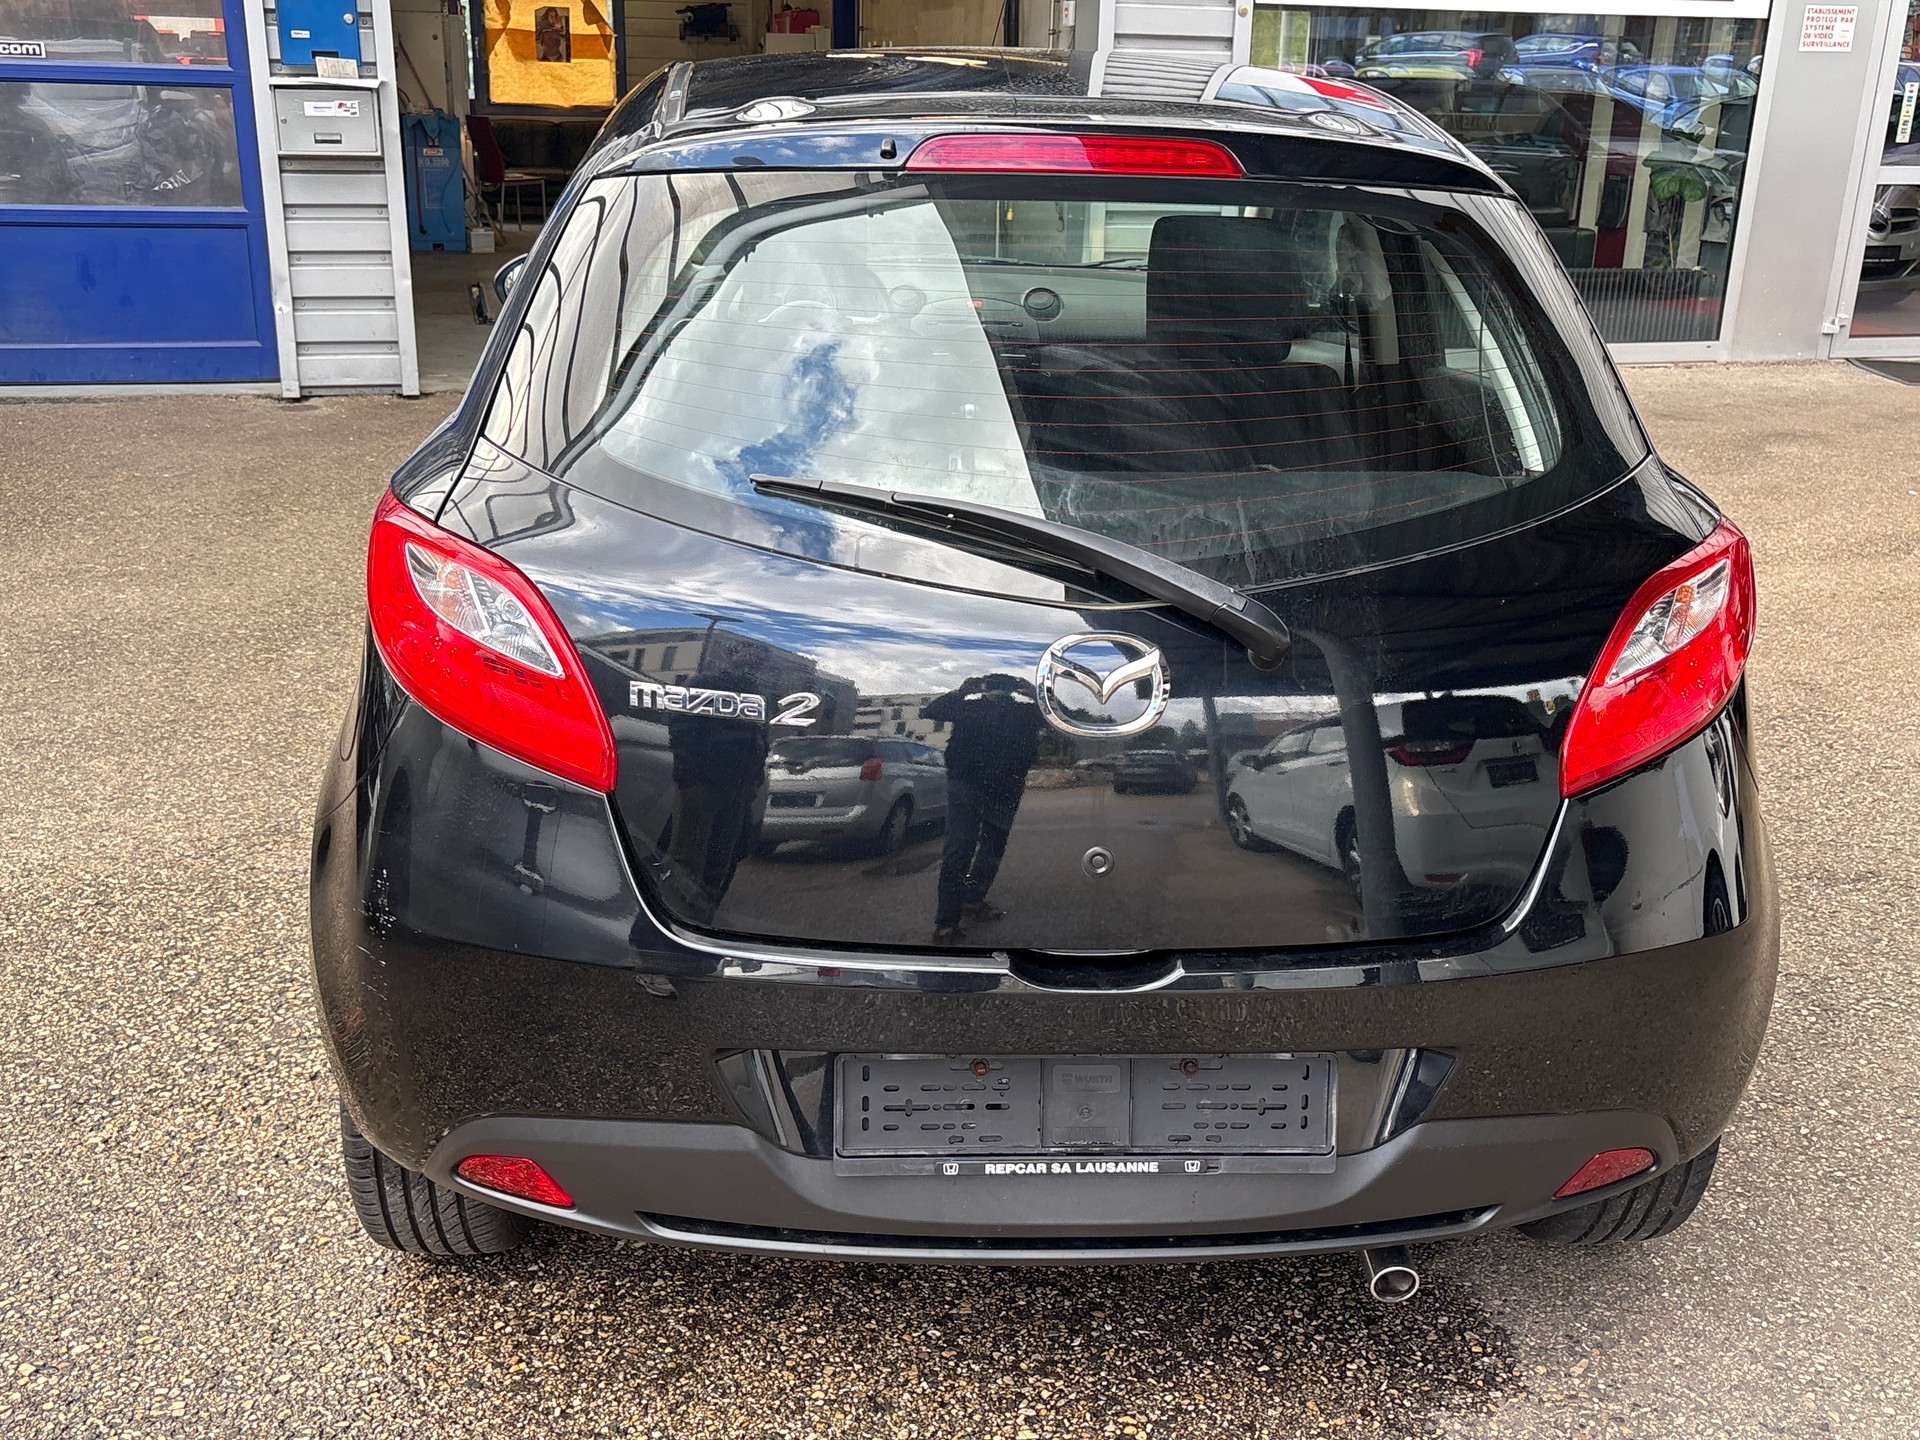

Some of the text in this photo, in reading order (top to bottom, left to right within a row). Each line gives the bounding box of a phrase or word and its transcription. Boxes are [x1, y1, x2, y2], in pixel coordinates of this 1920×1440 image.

[1807, 7, 1856, 15] ETABLISSEMENT
[1802, 40, 1850, 48] SURVEILLANCE
[769, 691, 821, 727] 2
[985, 1161, 1159, 1175] REPCAR SA LAUSANNE
